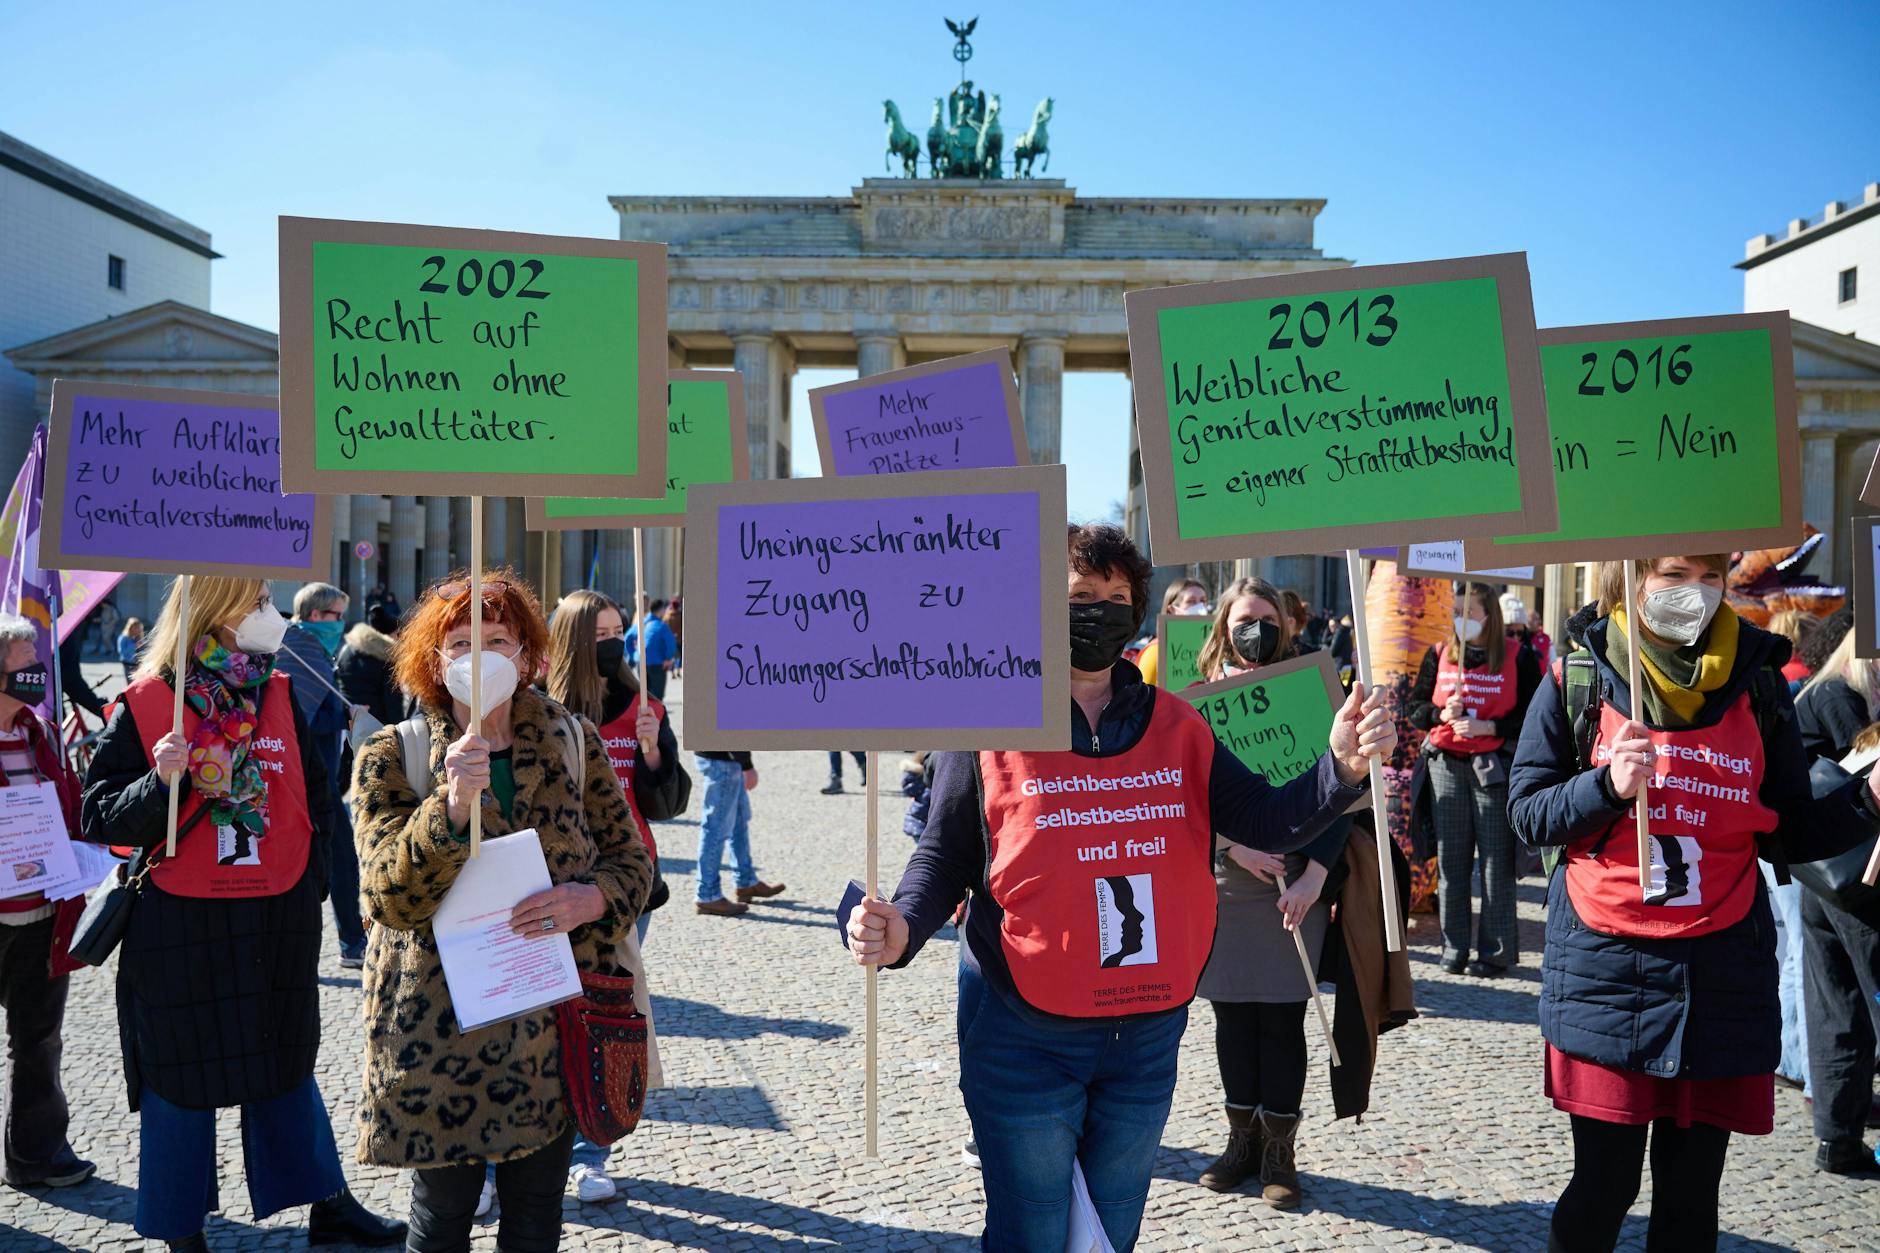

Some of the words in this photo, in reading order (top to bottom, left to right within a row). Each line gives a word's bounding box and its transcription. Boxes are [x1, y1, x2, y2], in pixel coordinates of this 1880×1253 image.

[419, 256, 551, 299] 2002
[327, 299, 443, 344] Recht
[473, 312, 541, 349] auf
[1268, 294, 1397, 350] 2013
[333, 352, 460, 392] Wohnen
[493, 358, 570, 397] ohne
[1173, 355, 1350, 406] Weibliche
[1578, 344, 1692, 396] 2016
[880, 390, 935, 418] Mehr
[1178, 379, 1498, 464] Genitalverstümmelung
[80, 411, 149, 448] Mehr
[335, 406, 555, 459] Gewalttäter.
[1554, 437, 1588, 473] in
[1616, 440, 1637, 456] =
[1658, 413, 1736, 461] Nein
[77, 463, 120, 484] zu
[153, 462, 280, 493] weiblicher
[1186, 484, 1207, 498] =
[1226, 463, 1309, 507] eigener
[1326, 427, 1515, 482] Straftatbestand
[75, 495, 310, 552] Genitalverstümmelung
[741, 514, 1012, 574] Uneingeschränkter
[1416, 549, 1457, 564] gewarnt
[745, 580, 869, 632] Zugang
[919, 583, 964, 608] zu
[1198, 685, 1270, 726] 1918
[1219, 722, 1296, 757] hrung
[1021, 767, 1182, 796] Gleichberechtig
[1034, 801, 1186, 829] selbstbestimm
[1674, 804, 1707, 827] frei!
[1077, 841, 1117, 862] und
[1125, 837, 1166, 858] frei!
[1097, 881, 1107, 912] FEMMES
[1100, 914, 1108, 930] DES
[1101, 931, 1109, 957] TERRE
[1093, 987, 1118, 997] TERRE
[1119, 986, 1136, 995] DES
[1137, 983, 1172, 992] FEMMES
[1094, 993, 1172, 1008] www.frauenrechte.de
